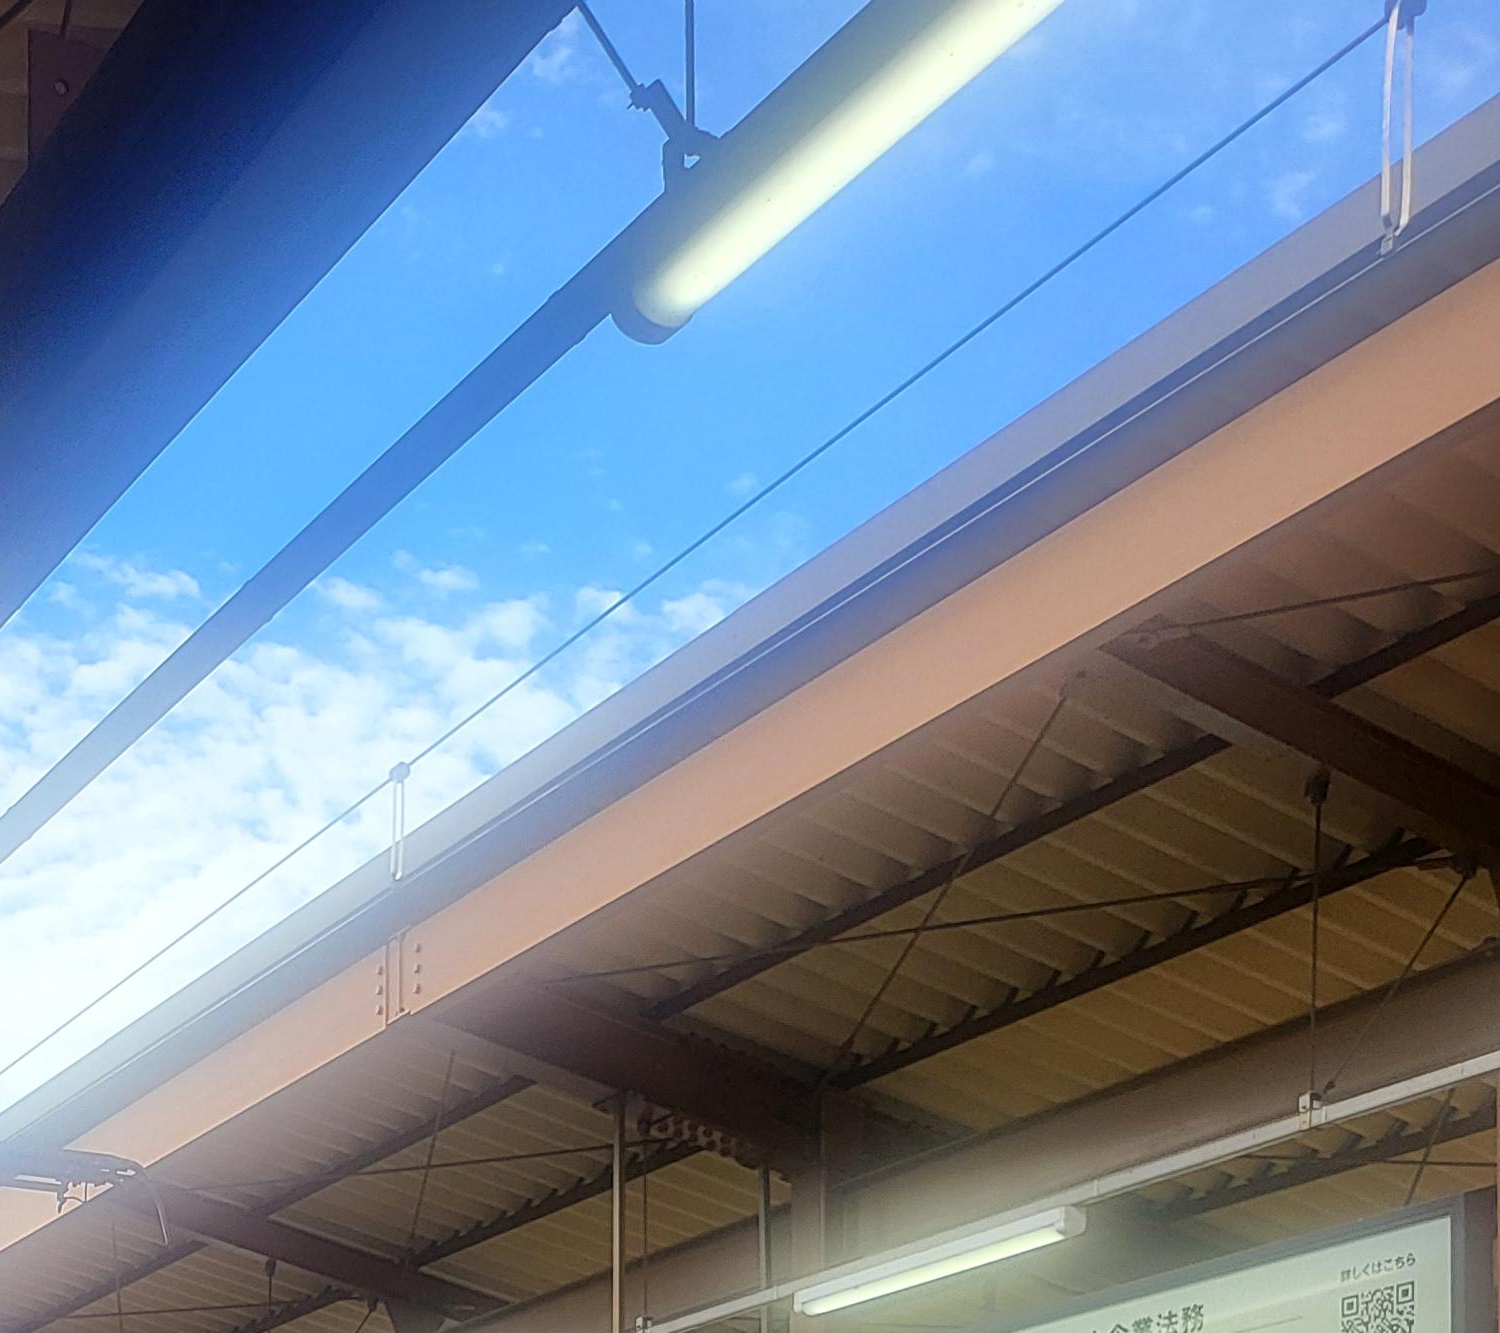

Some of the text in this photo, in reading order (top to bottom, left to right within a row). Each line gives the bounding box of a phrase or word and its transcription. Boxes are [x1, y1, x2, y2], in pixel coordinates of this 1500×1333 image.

[1340, 1253, 1416, 1282] 詳しくはこちら
